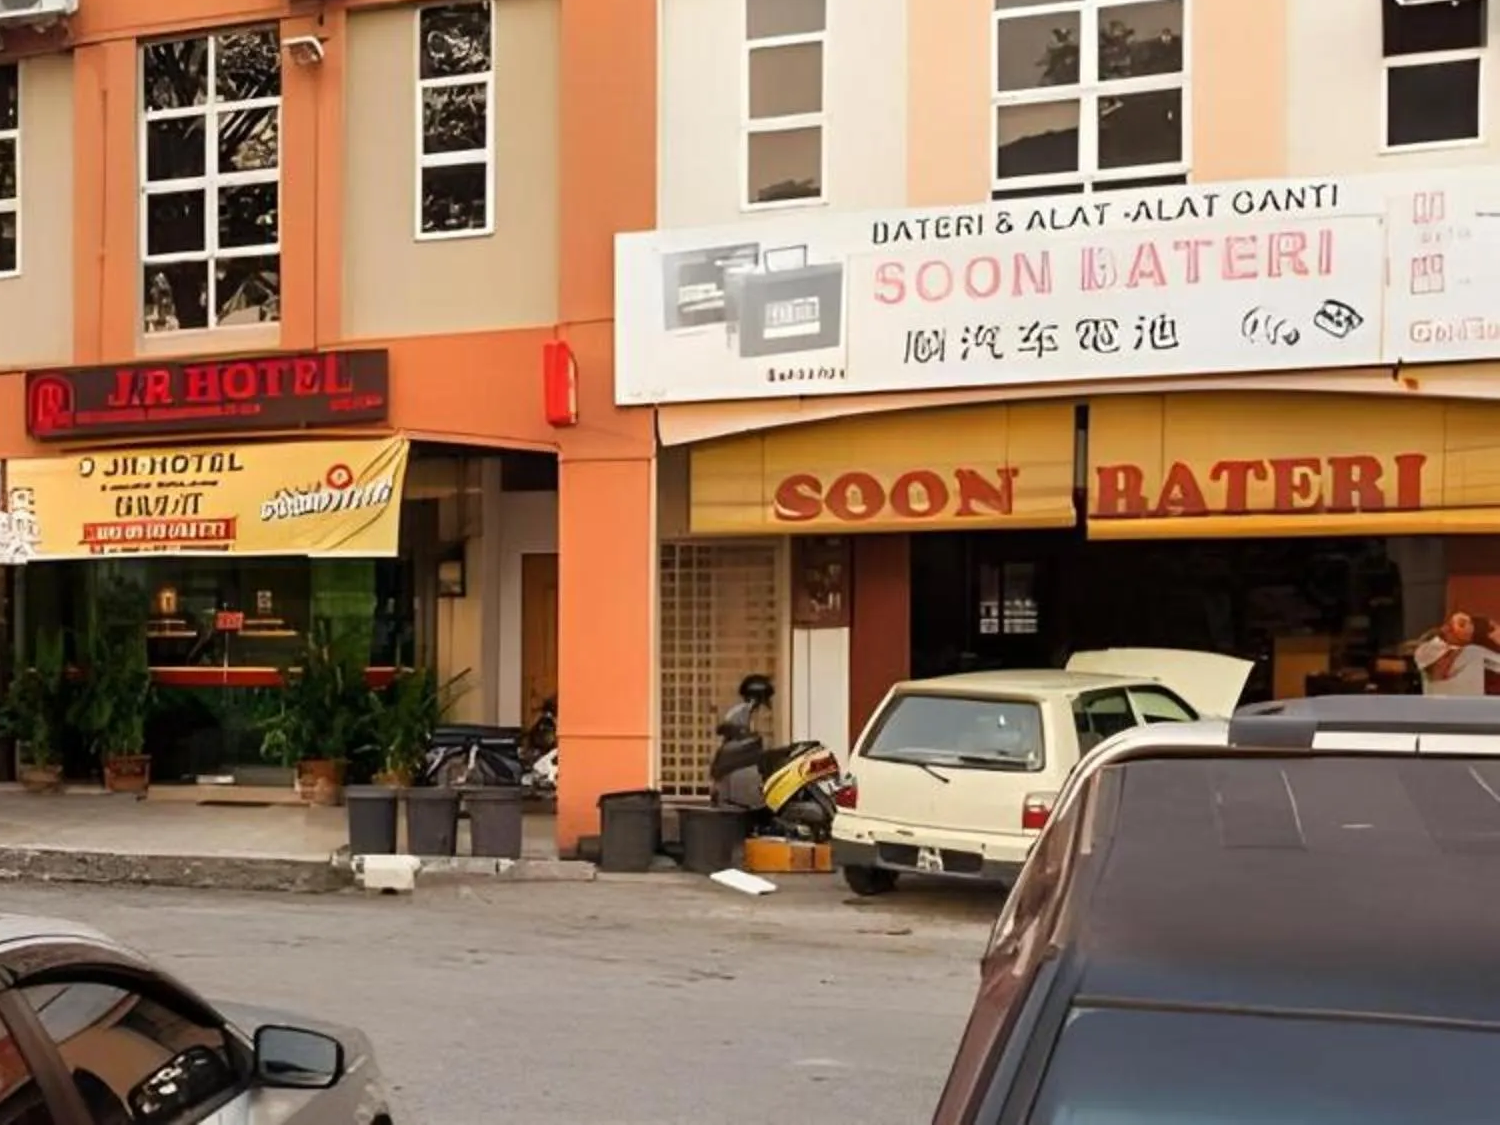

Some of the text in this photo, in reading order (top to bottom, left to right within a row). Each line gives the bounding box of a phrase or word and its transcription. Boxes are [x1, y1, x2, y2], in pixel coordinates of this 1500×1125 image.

[872, 248, 1053, 306] SOON
[183, 351, 353, 402] HOTEL
[773, 453, 1429, 522] SOON BATERI
